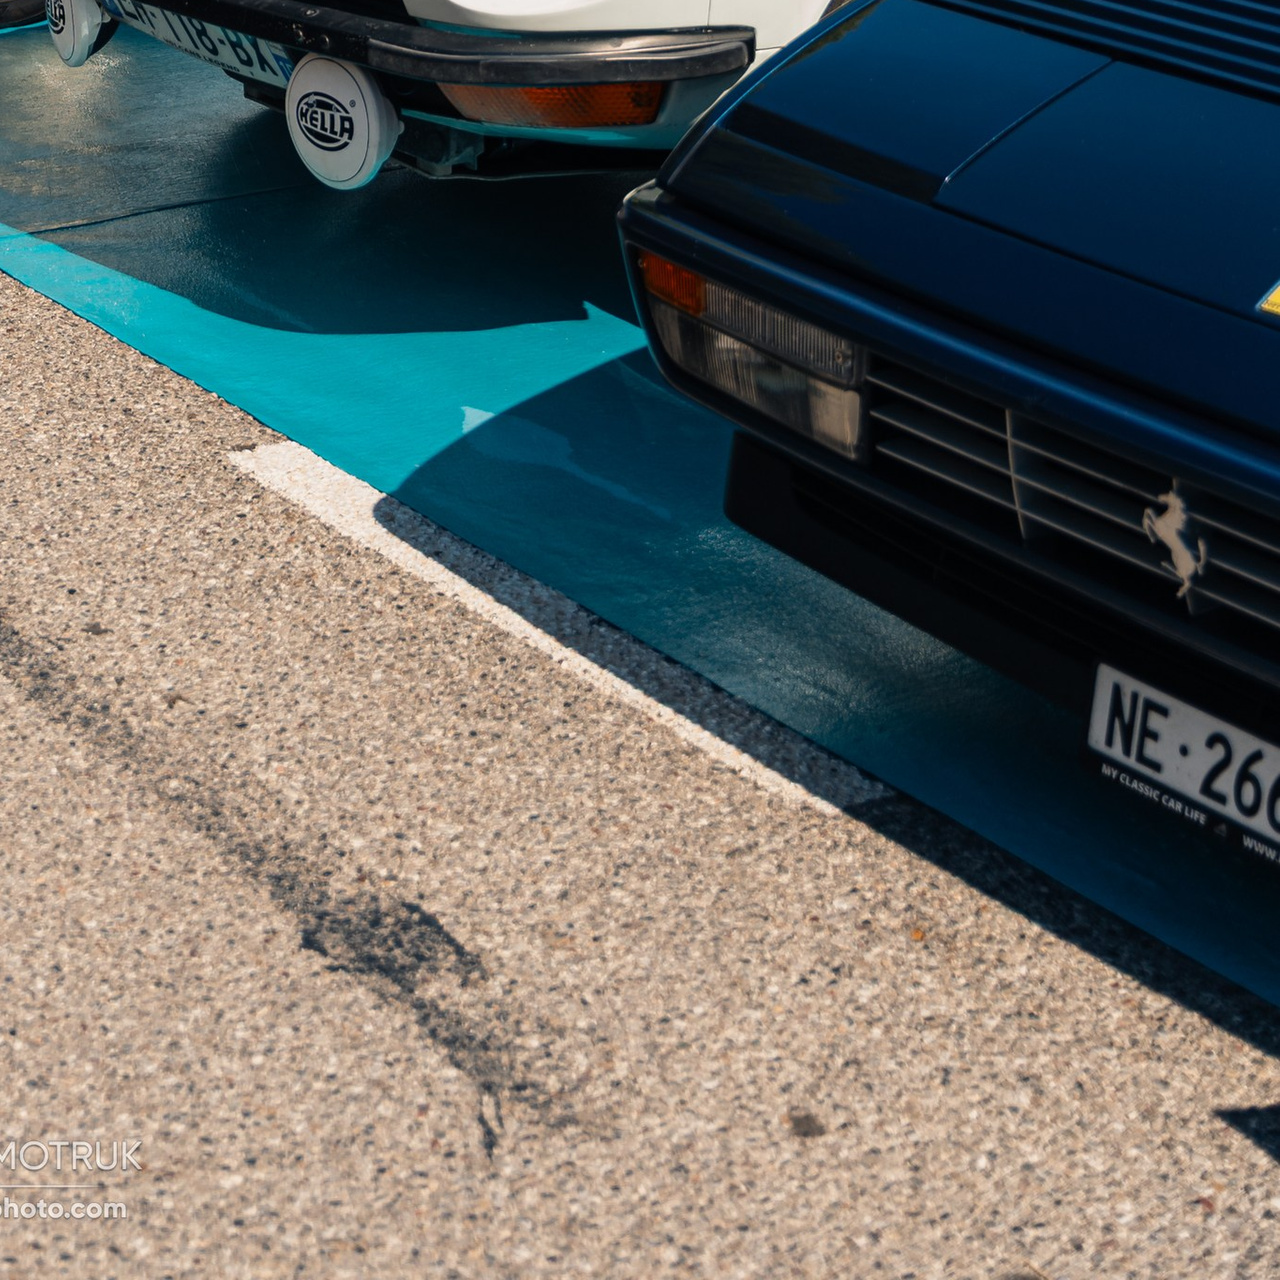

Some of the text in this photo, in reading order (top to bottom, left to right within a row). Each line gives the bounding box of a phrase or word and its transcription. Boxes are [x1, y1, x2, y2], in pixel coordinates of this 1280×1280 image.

[298, 103, 355, 141] HELLA
[1101, 762, 1208, 826] MY CLASSIC CAR LIFE
